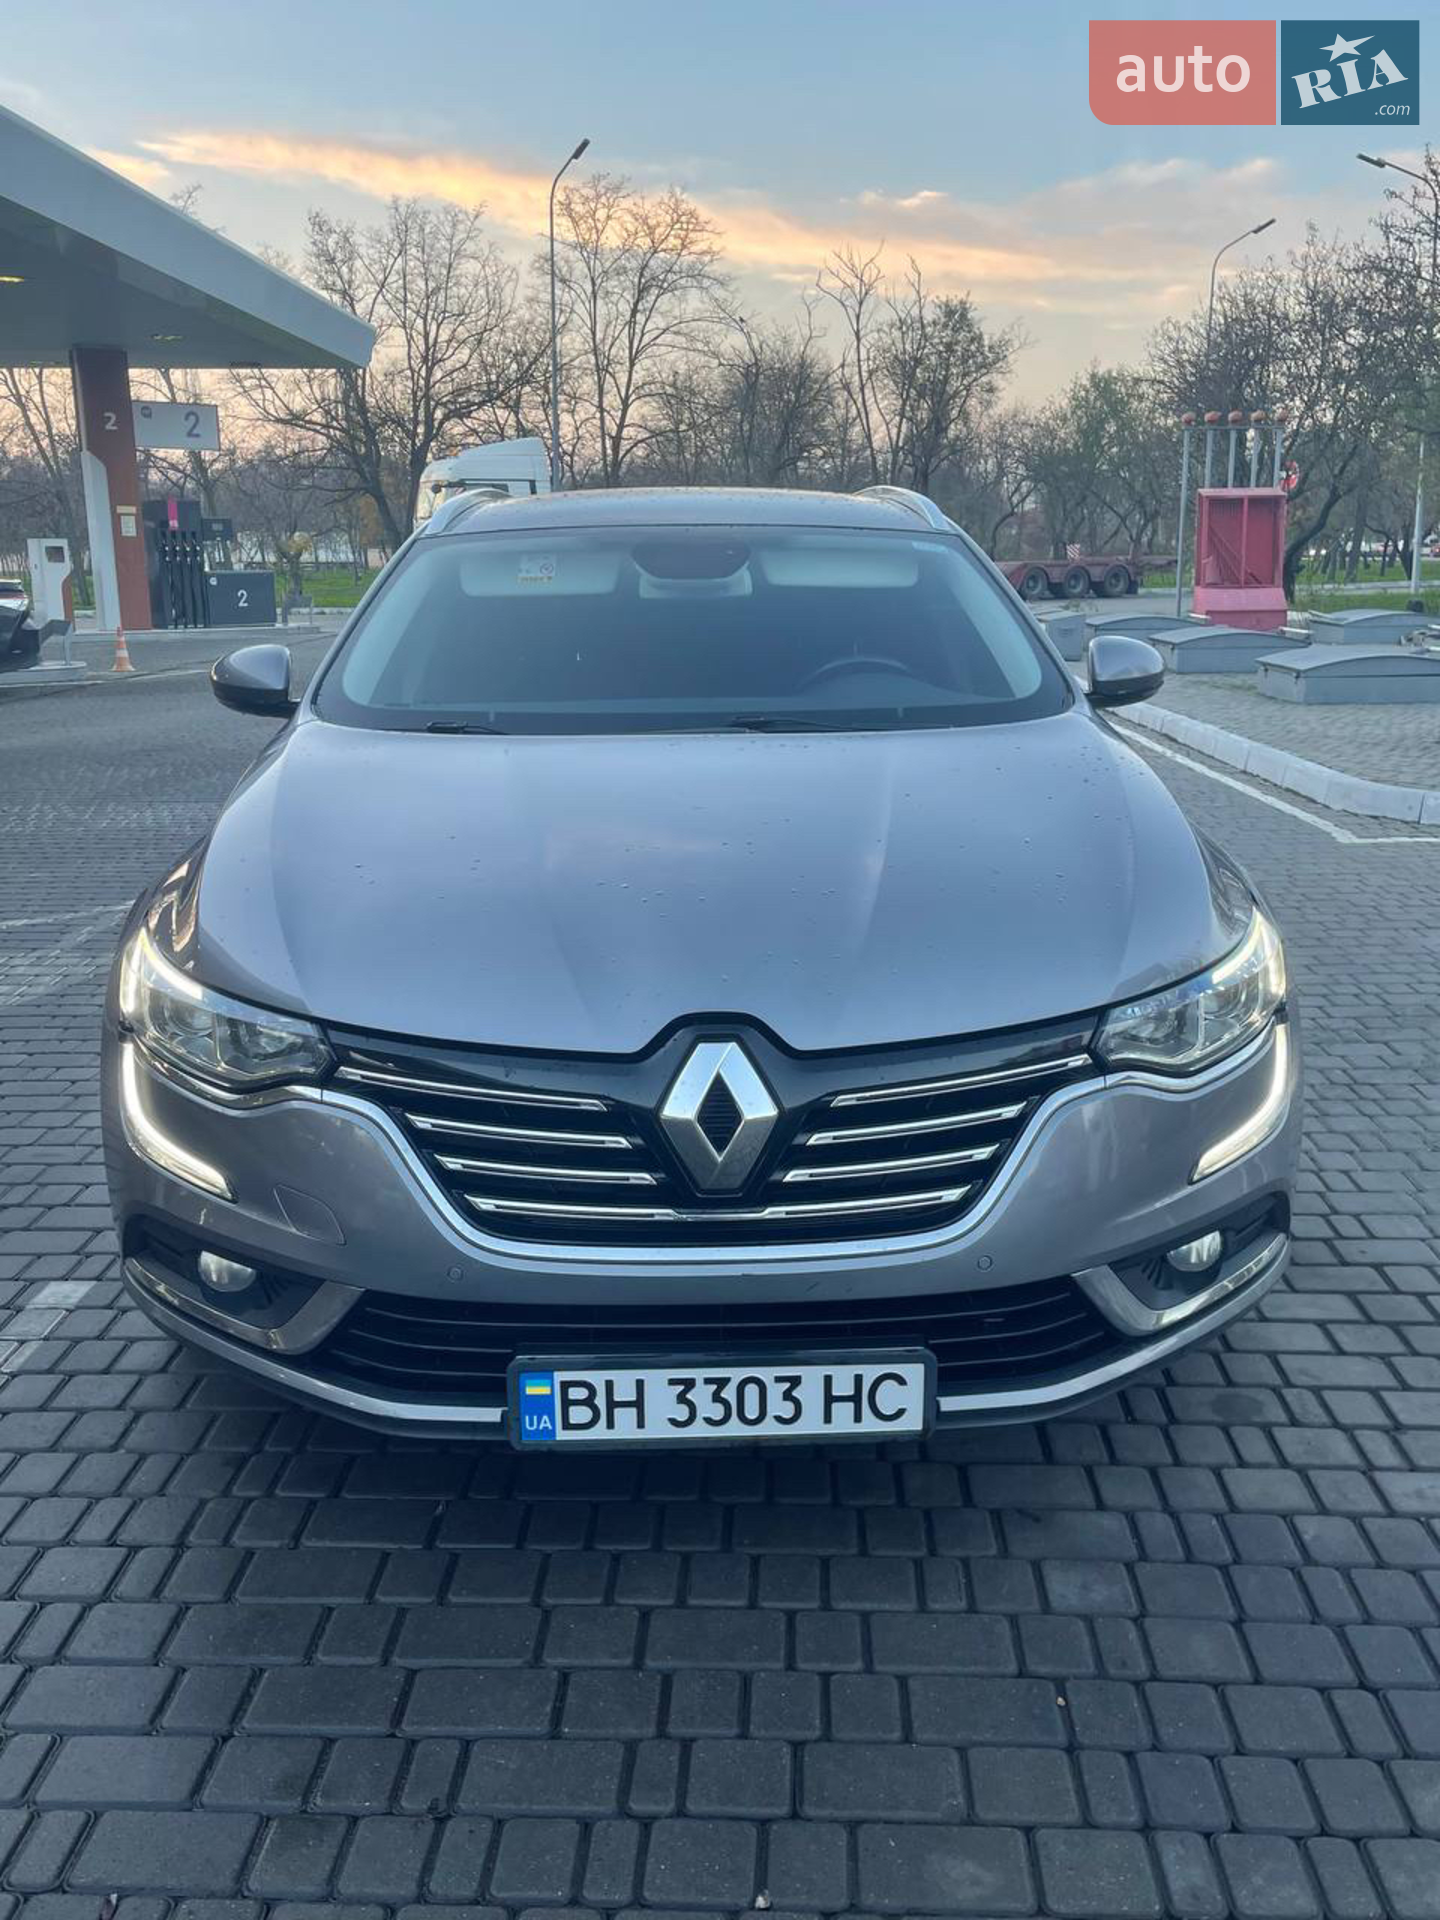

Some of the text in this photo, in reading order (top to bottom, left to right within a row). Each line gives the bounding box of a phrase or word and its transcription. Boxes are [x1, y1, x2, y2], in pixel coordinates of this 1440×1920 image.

[103, 412, 118, 430] 2
[184, 410, 201, 438] 2
[237, 589, 249, 607] 2
[559, 1371, 908, 1431] BH 3303 HC
[525, 1414, 553, 1431] UA
